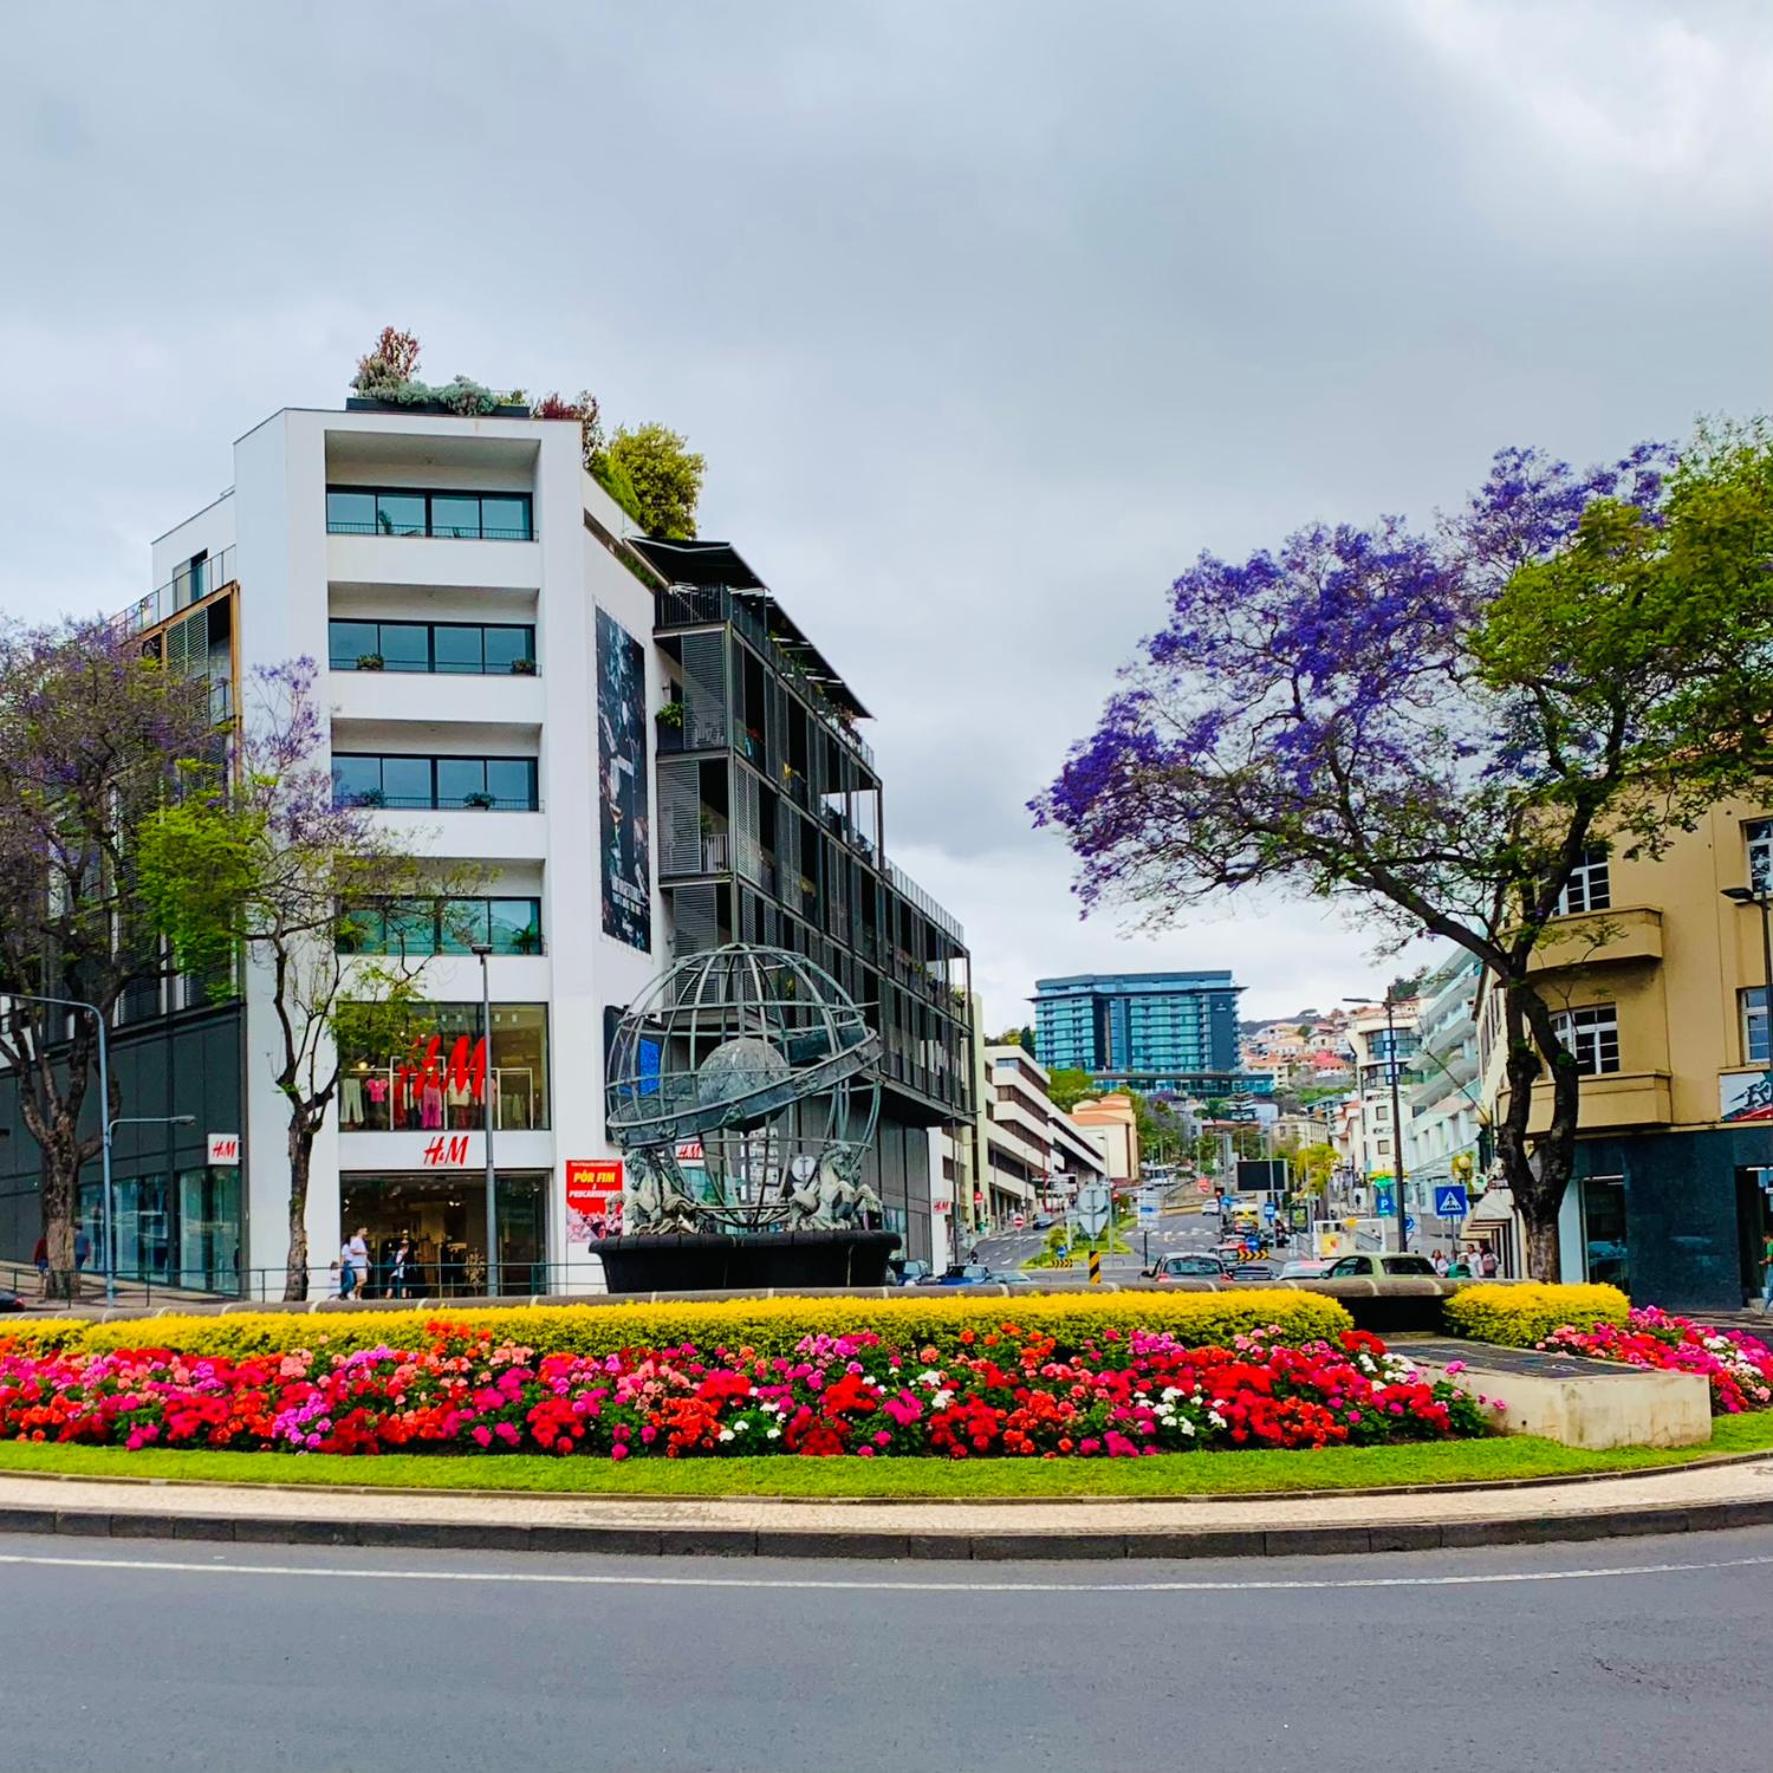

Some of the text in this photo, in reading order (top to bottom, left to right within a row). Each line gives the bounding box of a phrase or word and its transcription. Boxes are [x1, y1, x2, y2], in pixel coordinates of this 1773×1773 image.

[213, 1140, 236, 1158] H&M
[424, 1135, 469, 1166] H&M
[1380, 1198, 1389, 1209] P
